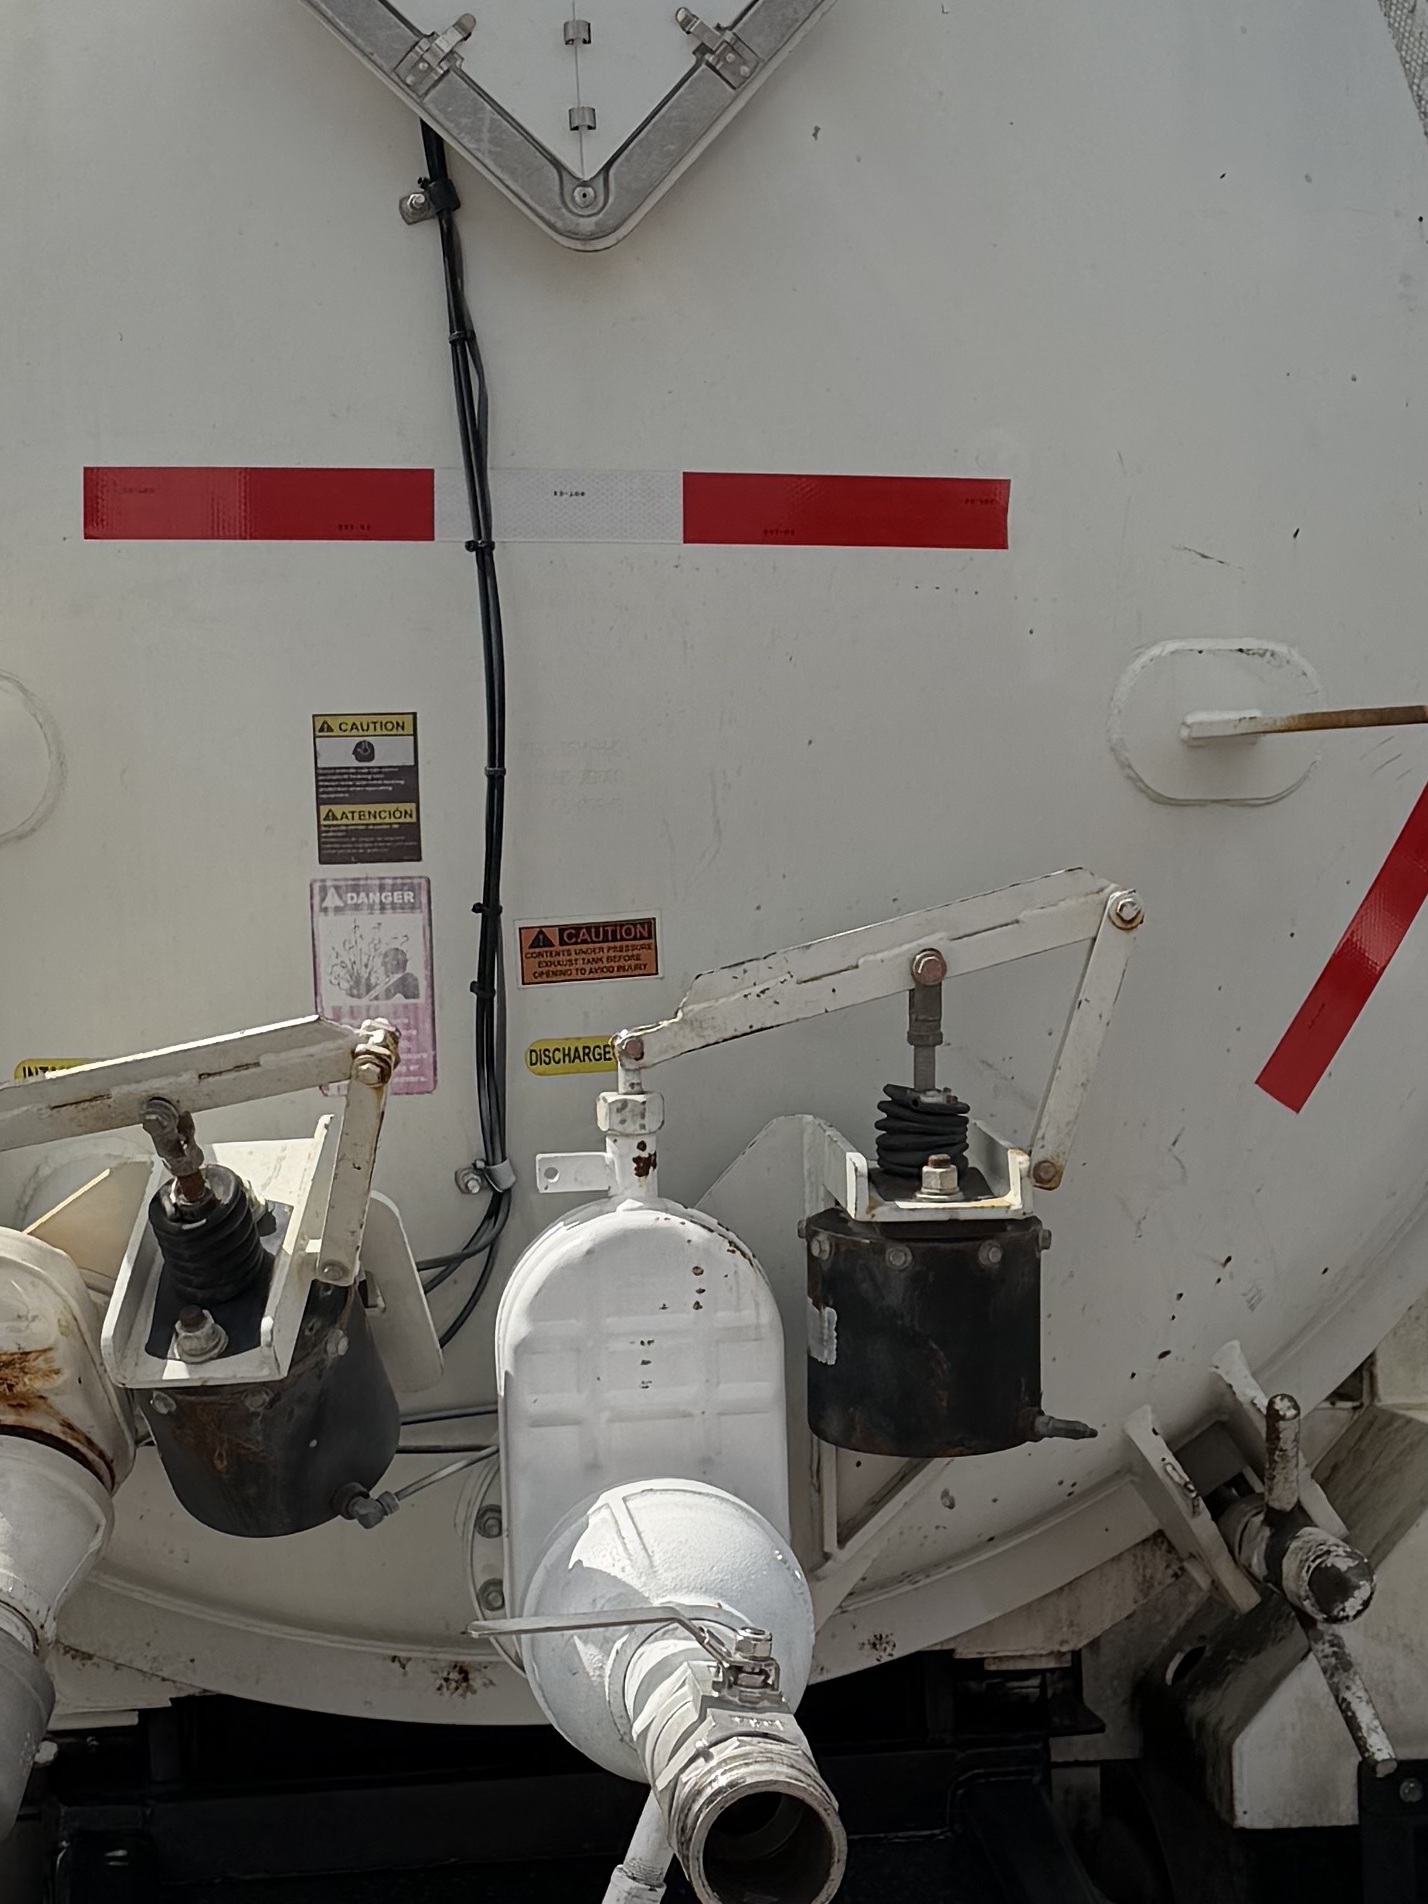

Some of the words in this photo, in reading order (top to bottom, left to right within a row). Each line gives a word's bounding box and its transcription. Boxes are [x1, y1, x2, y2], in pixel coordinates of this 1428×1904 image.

[338, 720, 405, 733] CAUTION
[339, 807, 414, 821] ATENCIÓN
[346, 891, 415, 905] DANGER
[563, 923, 649, 944] CAUTION
[525, 947, 572, 959] CONTENTS
[574, 946, 605, 957] UNDER
[606, 943, 654, 953] PRESSURE
[537, 958, 579, 969] EXHAUST
[581, 957, 605, 966] TANK
[606, 954, 642, 963] BEFORE
[532, 969, 572, 980] OPENING
[575, 967, 587, 976] TO
[616, 963, 648, 974] INJURY
[529, 1044, 613, 1066] DISCHARGE
